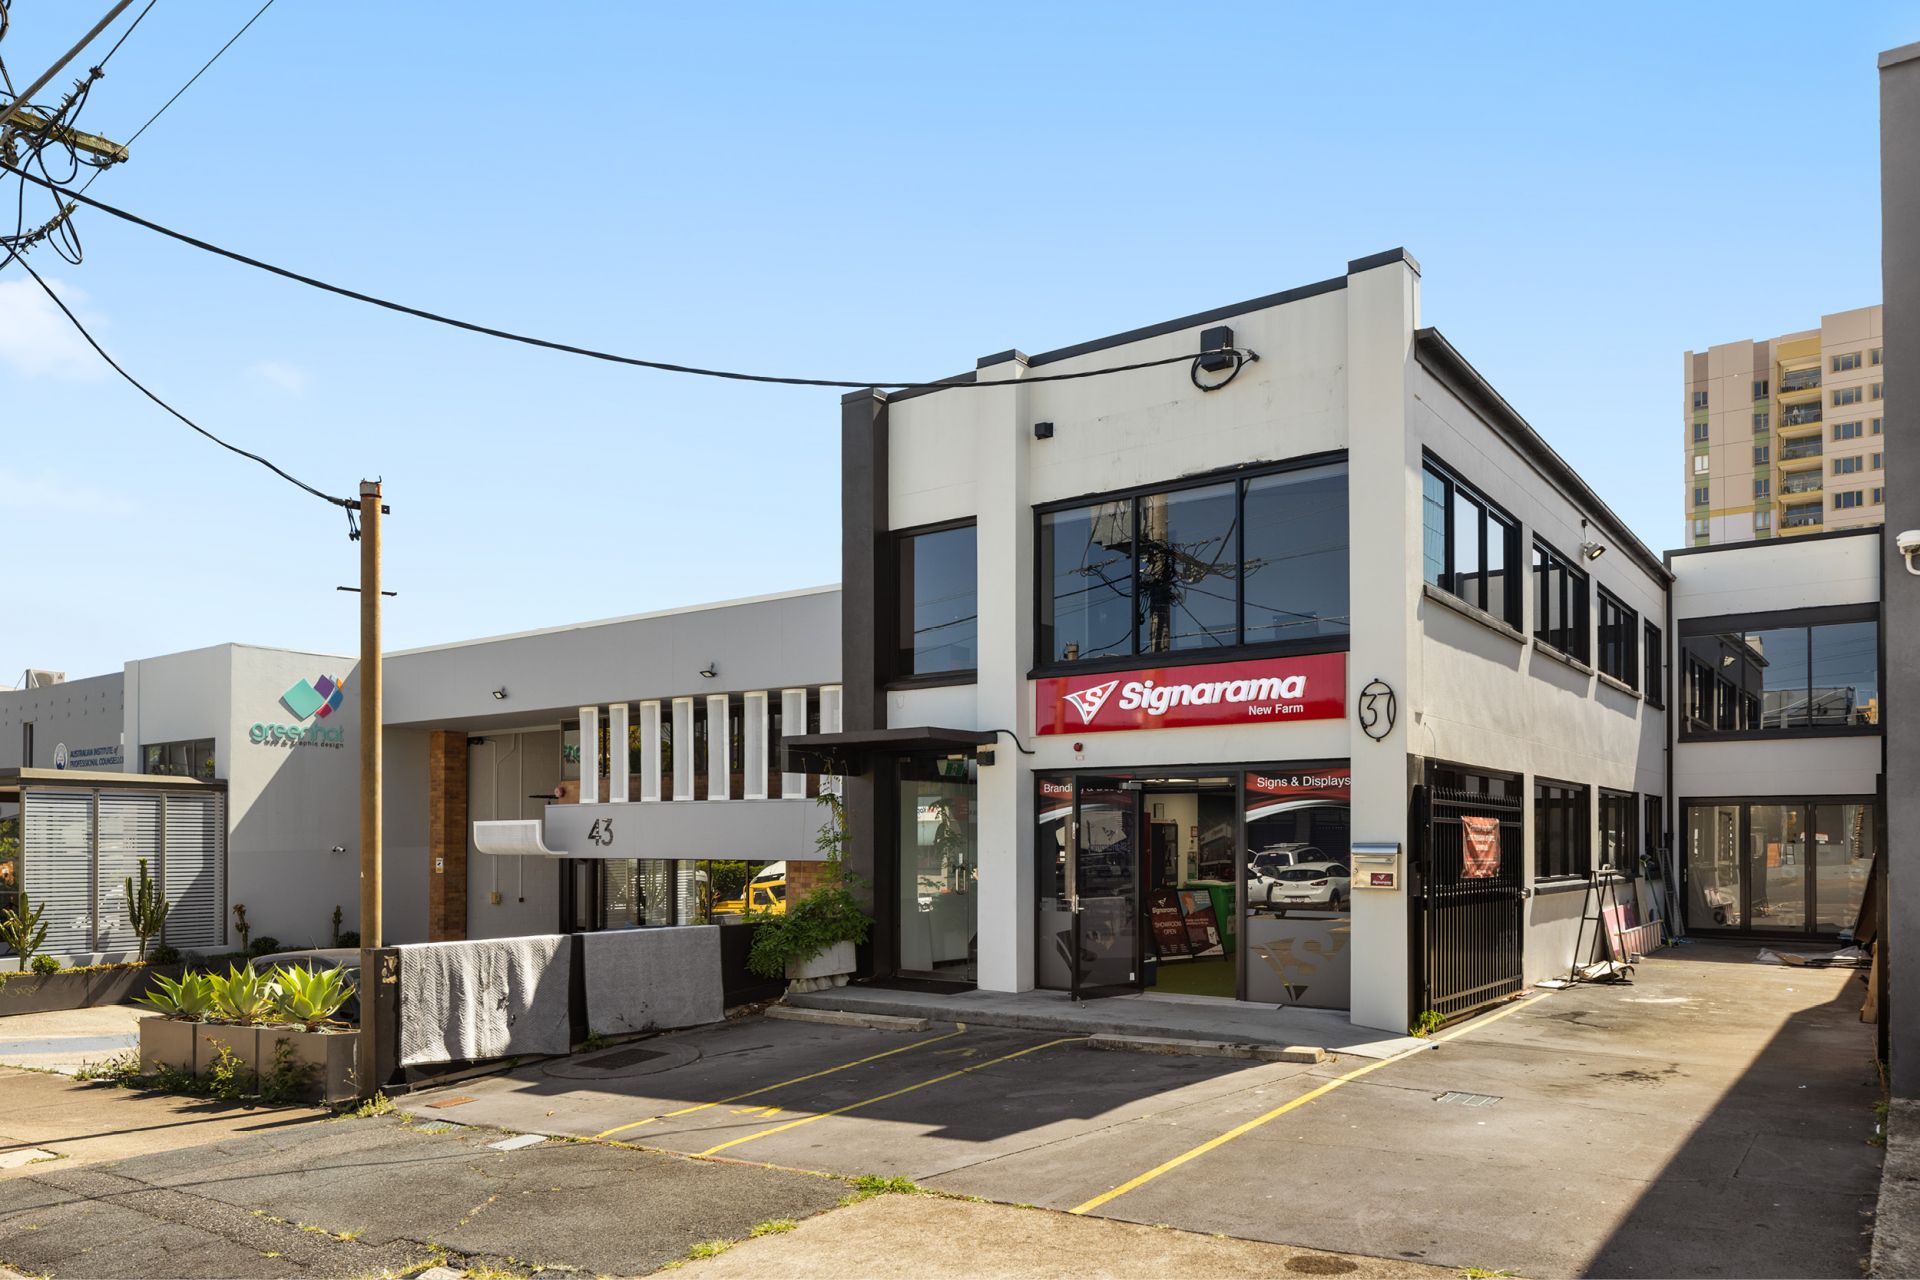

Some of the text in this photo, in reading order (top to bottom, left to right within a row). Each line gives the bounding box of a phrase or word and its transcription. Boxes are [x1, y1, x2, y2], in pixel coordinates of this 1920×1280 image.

[1119, 675, 1308, 715] Signarama
[1248, 703, 1304, 716] New Farm
[250, 722, 344, 752] greenhat
[320, 740, 345, 750] design
[1257, 775, 1351, 790] Signs & Displays
[587, 817, 614, 846] 43
